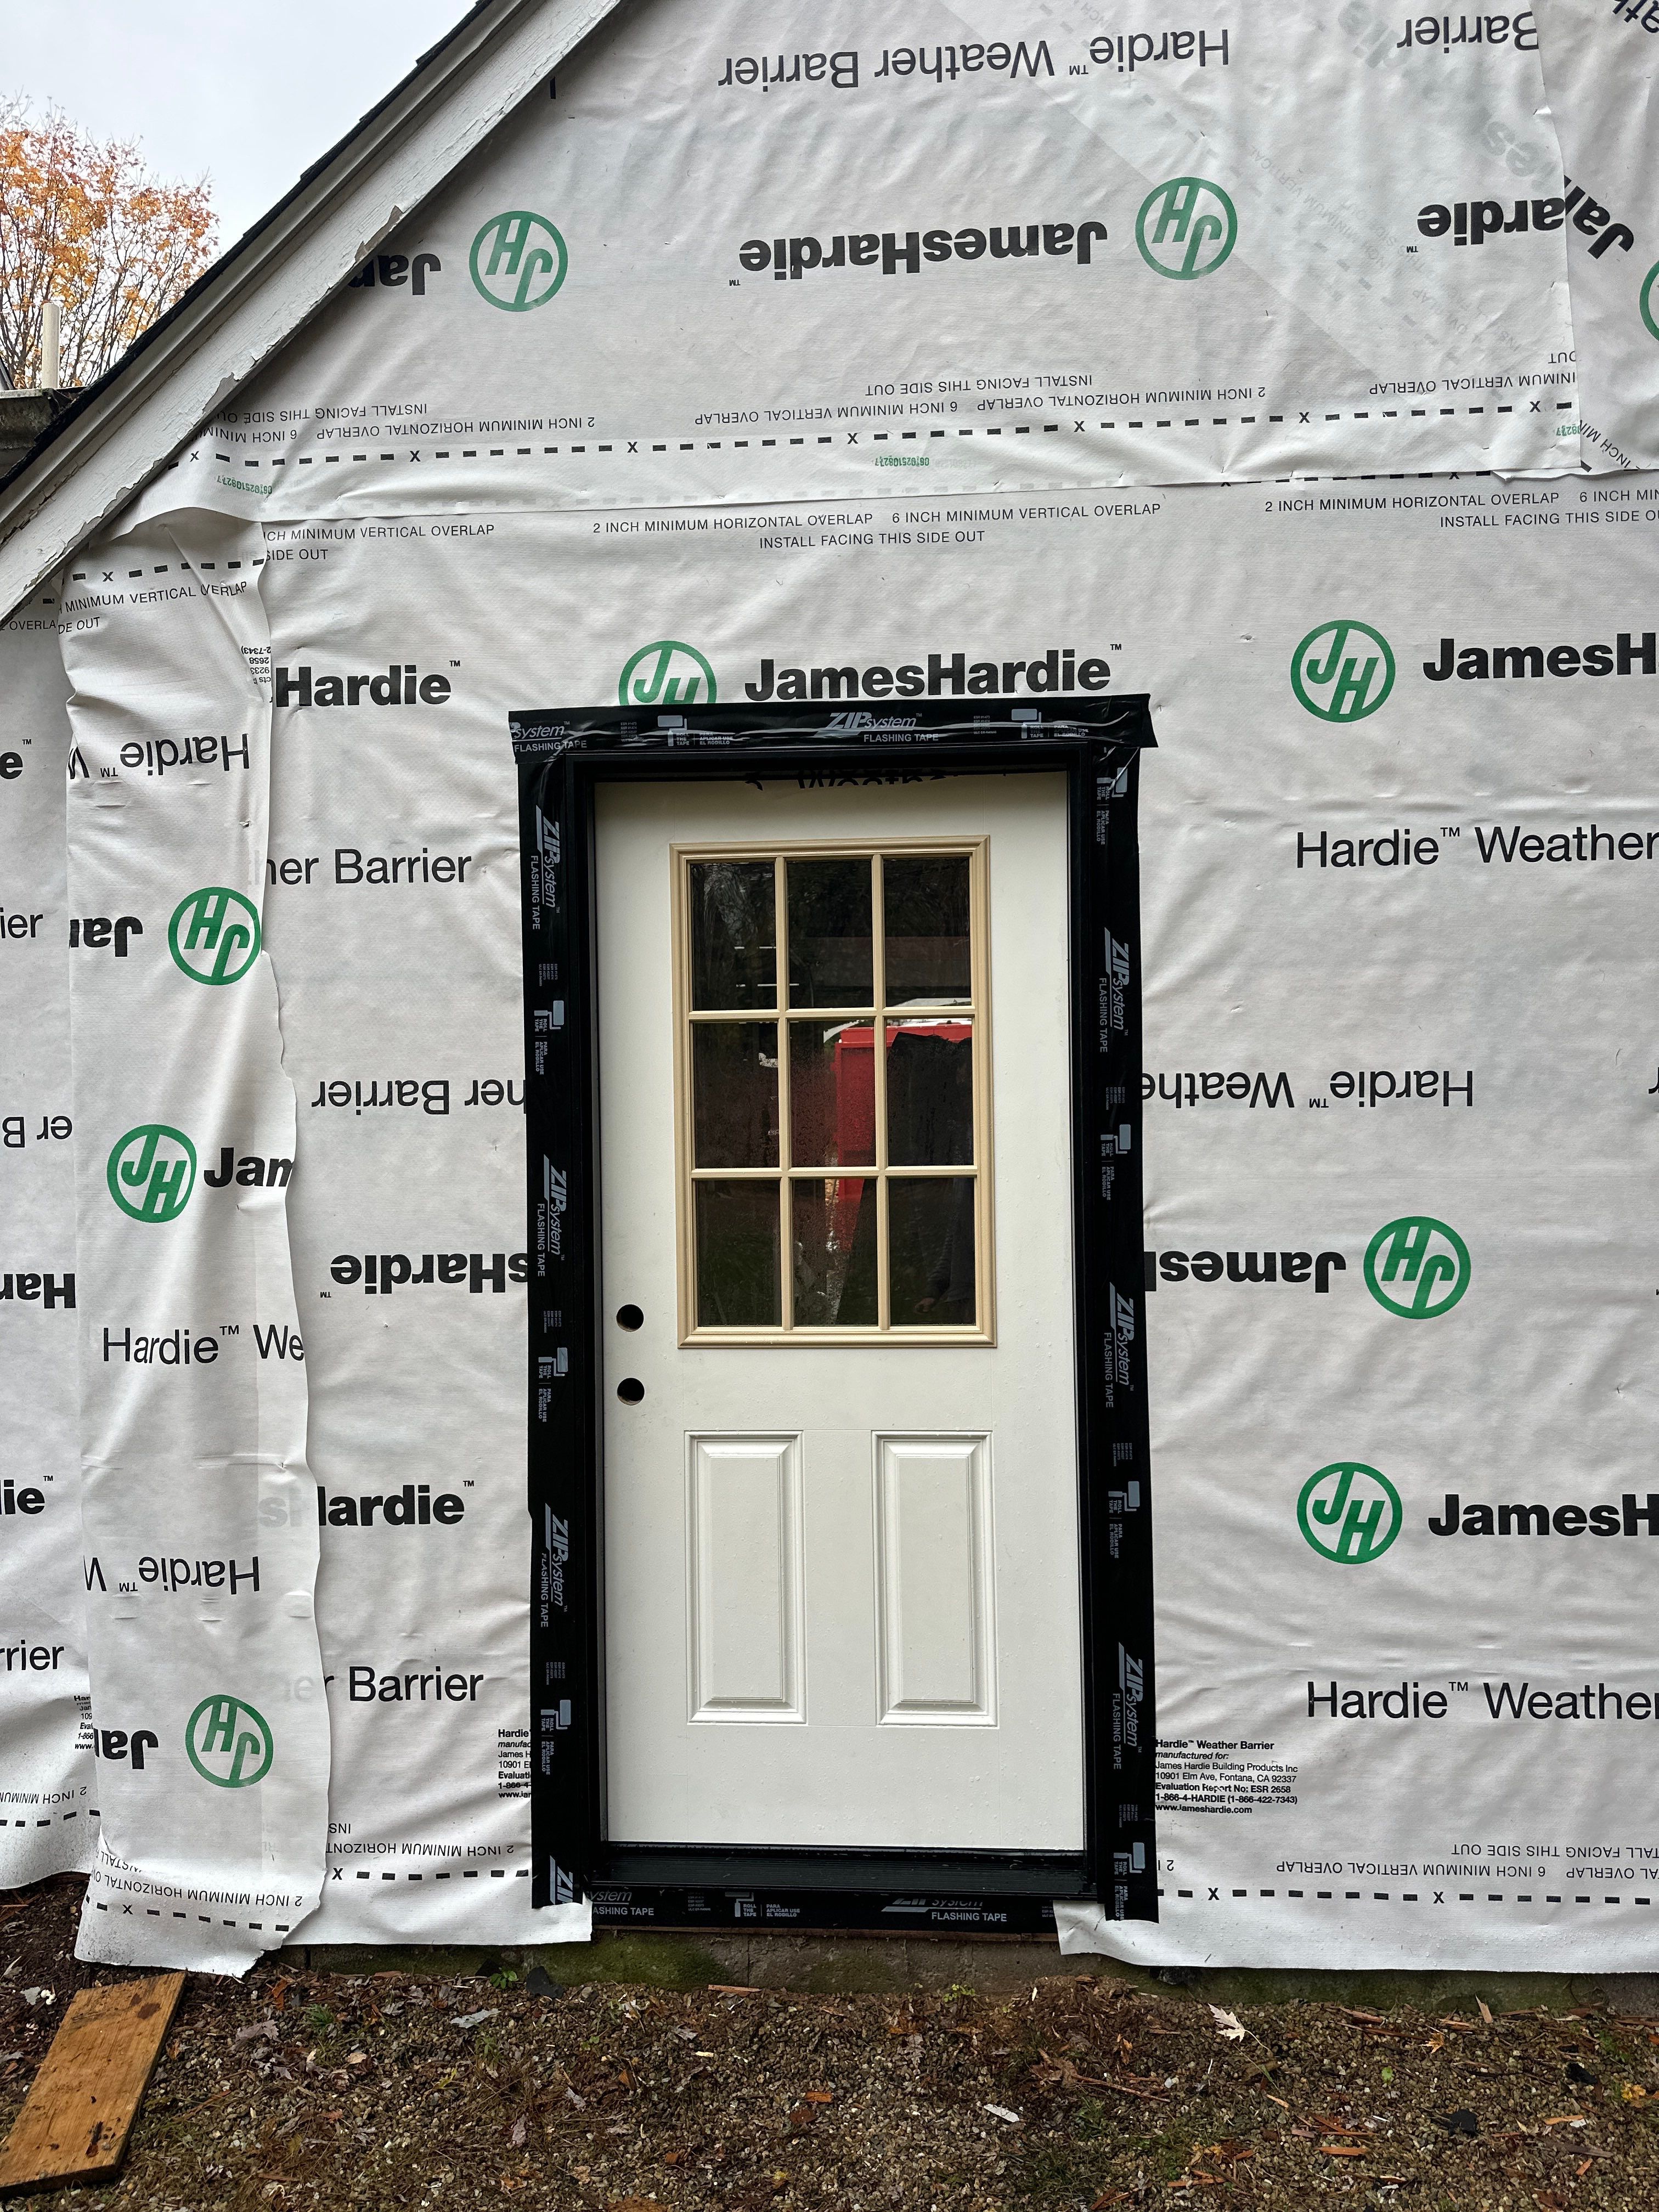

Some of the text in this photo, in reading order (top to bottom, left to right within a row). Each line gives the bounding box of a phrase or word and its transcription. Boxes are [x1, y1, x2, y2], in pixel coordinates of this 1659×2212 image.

[718, 51, 859, 92] Barrier
[874, 40, 1055, 83] Weather
[865, 375, 1092, 396] INSTALL FACING THIS SIDE OUT
[1369, 376, 1513, 395] VERTICAL OVERLAP
[244, 403, 427, 424] INSTALL FACING THIS SIDE
[695, 387, 1265, 425] 2 INCH MINIMUM HORIZONTAL OVERLAP 6 INCH MINIMUM VERTICAL OVERLAP
[252, 417, 595, 443] 2 INCH MINIMUM HORIZONTAL OVERLAP 6 INCH
[1265, 490, 1630, 512] 2 INCH MINIMUM HORIZONTAL OVERLAP 6 INCH
[593, 503, 1160, 533] 2 INCH MINIMUM HORIZONTAL OVERLAP 6 INCH MINIMUM VERTICAL OVERLAP
[1441, 510, 1639, 528] INSTALL FACING THIS SIDE
[291, 524, 494, 540] MINIMUM VERTICAL OVERLAP
[760, 531, 985, 549] INSTALL FACING THIS SIDE OUT
[65, 594, 124, 613] MINIMUM
[129, 586, 197, 603] VERTICAL
[76, 616, 100, 630] OUT
[864, 733, 939, 743] FLASHING TAPE
[1475, 823, 1659, 864] Weather
[335, 848, 471, 884] Barrier
[531, 855, 540, 902] FLASHING
[1099, 978, 1108, 1052] FLASHING TAPE
[311, 1080, 450, 1115] Barrier
[1104, 1333, 1114, 1408] FLASHING TAPE
[349, 1666, 484, 1702] Barrier
[1155, 1751, 1213, 1759] manufactured
[1196, 1740, 1238, 1750] Weather
[1240, 1741, 1275, 1750] Barrier
[1199, 1772, 1217, 1782] Ave,
[1220, 1773, 1255, 1784] Fontana,
[1257, 1774, 1270, 1782] CA
[1271, 1775, 1297, 1783] 92337
[1212, 1762, 1245, 1773] Building
[1246, 1763, 1284, 1772] Products
[1285, 1764, 1298, 1773] Inc
[43, 1786, 87, 1804] 2 INCH
[1155, 1783, 1200, 1791] Evaluation
[1233, 1784, 1249, 1793] No:
[1250, 1785, 1269, 1793] ESR
[1271, 1785, 1291, 1793] 2658
[1451, 1844, 1620, 1858] FACING THIS SIDE OUT
[1276, 1861, 1634, 1879] OVERLAP 6 INCH MINIMUM VERTICAL OVERLAP
[104, 1875, 303, 1907] 2 INCH MINIMUM HORIZONTAL
[932, 1912, 1007, 1922] FLASHING TAPE
